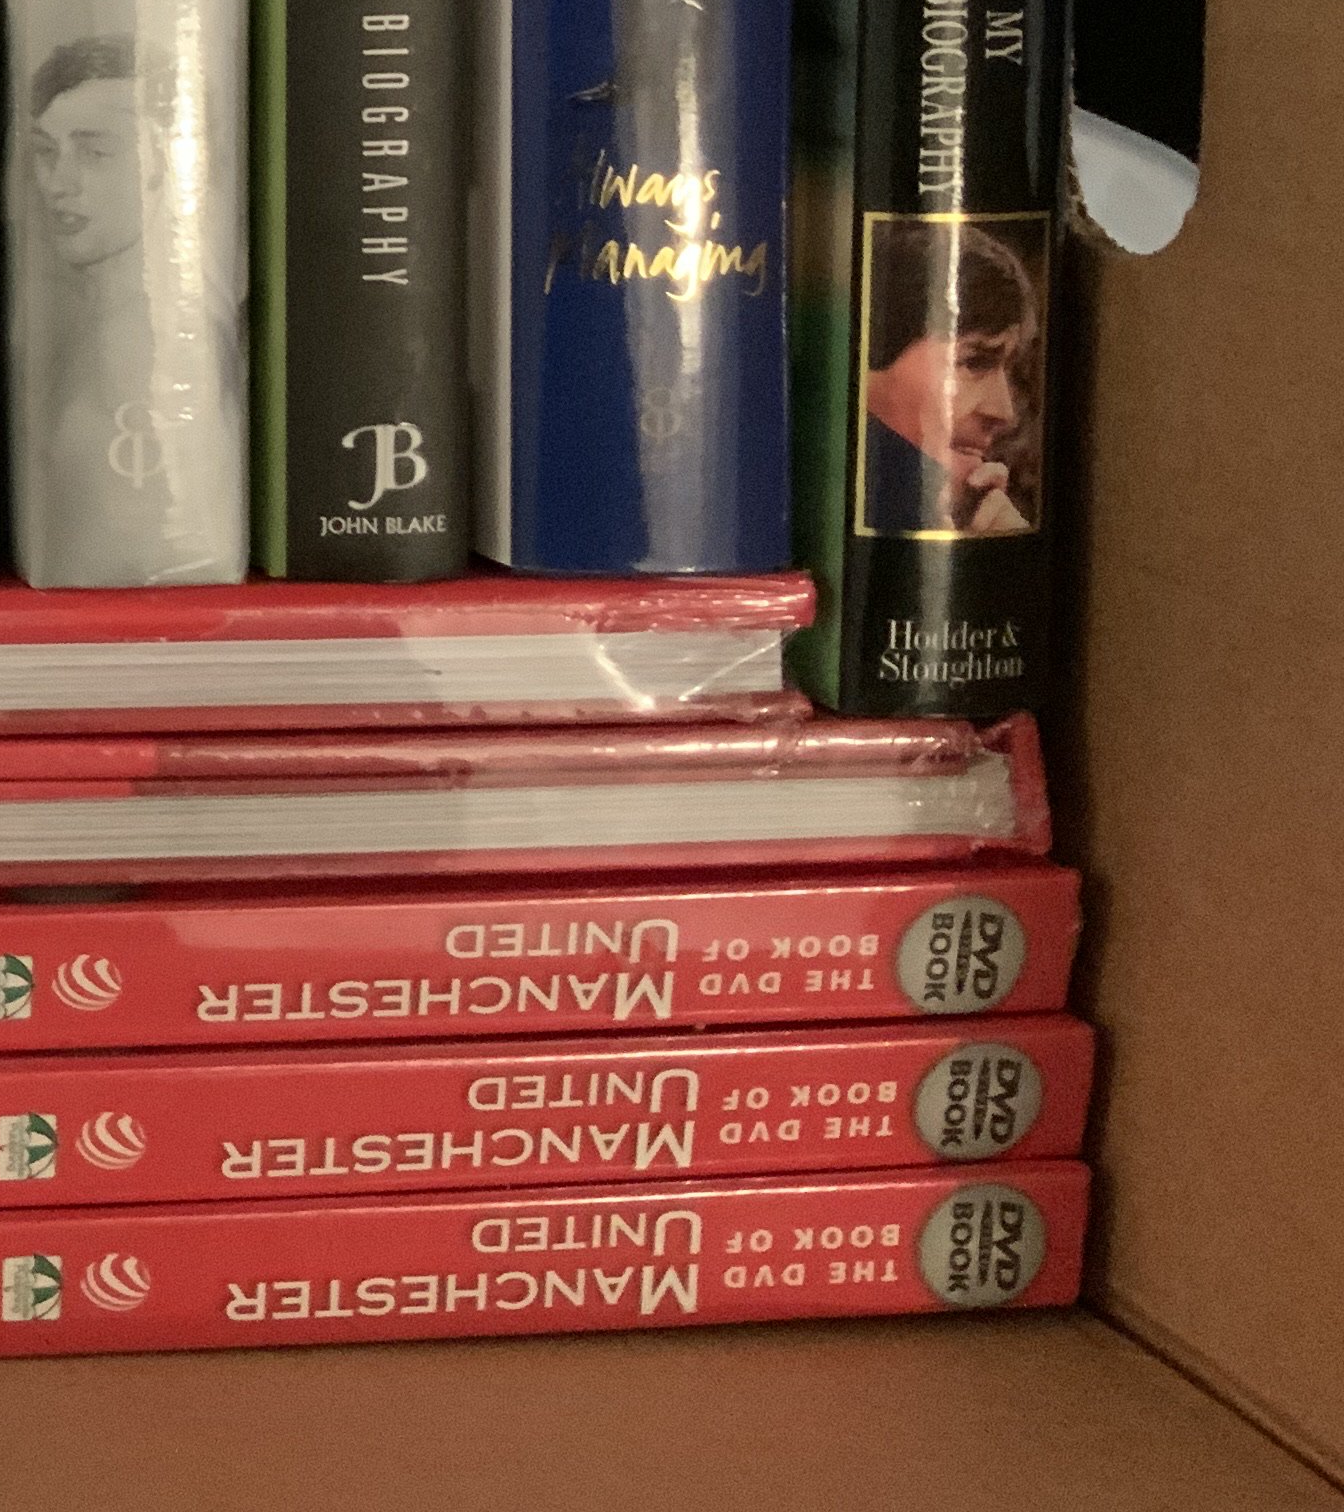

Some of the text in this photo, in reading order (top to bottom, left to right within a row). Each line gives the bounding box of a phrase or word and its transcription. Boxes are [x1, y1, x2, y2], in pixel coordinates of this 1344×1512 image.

[985, 10, 1023, 66] MY
[362, 14, 410, 286] BIOGRAPHY
[320, 514, 447, 536] JOHN BLAKE
[886, 619, 998, 651] Hodder
[879, 648, 1025, 688] Stoughton
[445, 918, 680, 963] UNITED
[702, 933, 879, 963] BOOK OF
[924, 913, 955, 1002] BOOK
[973, 912, 1005, 1000] DVD
[197, 972, 674, 1023] MANCHESTER
[699, 968, 877, 996] THE DVD
[467, 1068, 700, 1113] UNITED
[723, 1081, 897, 1113] BOOK OF
[940, 1060, 973, 1148] BOOK
[990, 1058, 1022, 1145] DVD
[221, 1121, 695, 1180] MANCHESTER
[720, 1116, 893, 1146] THE DVD
[471, 1209, 703, 1255] UNITED
[727, 1223, 900, 1254] BOOK OF
[948, 1202, 974, 1293] BOOK
[995, 1201, 1025, 1291] DVD
[225, 1261, 700, 1321] MANCHESTER
[724, 1259, 897, 1288] THE DVD
